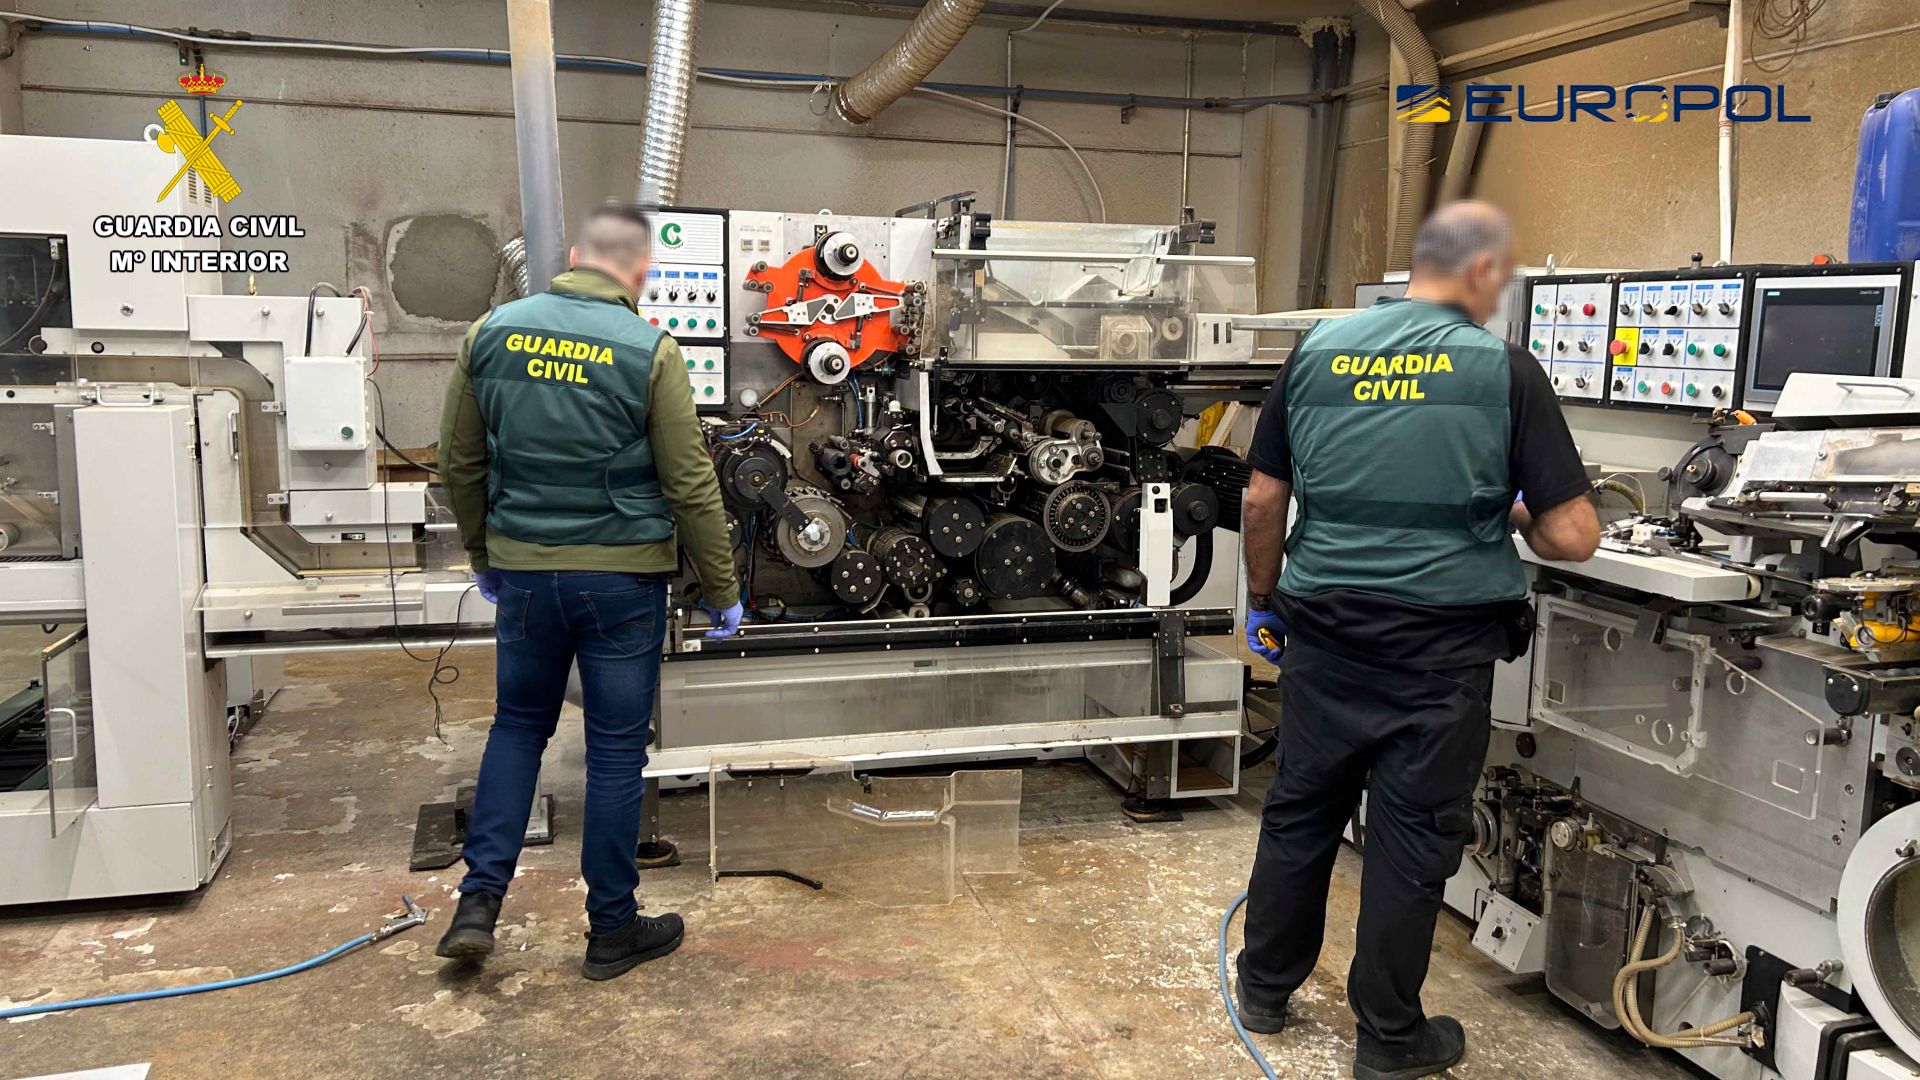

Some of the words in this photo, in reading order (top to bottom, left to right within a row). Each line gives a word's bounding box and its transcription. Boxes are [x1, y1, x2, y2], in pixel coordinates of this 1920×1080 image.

[506, 333, 614, 366] GUARDIA
[527, 358, 589, 384] CIVIL
[1331, 353, 1454, 376] GUARDIA
[1353, 379, 1425, 401] CIVIL
